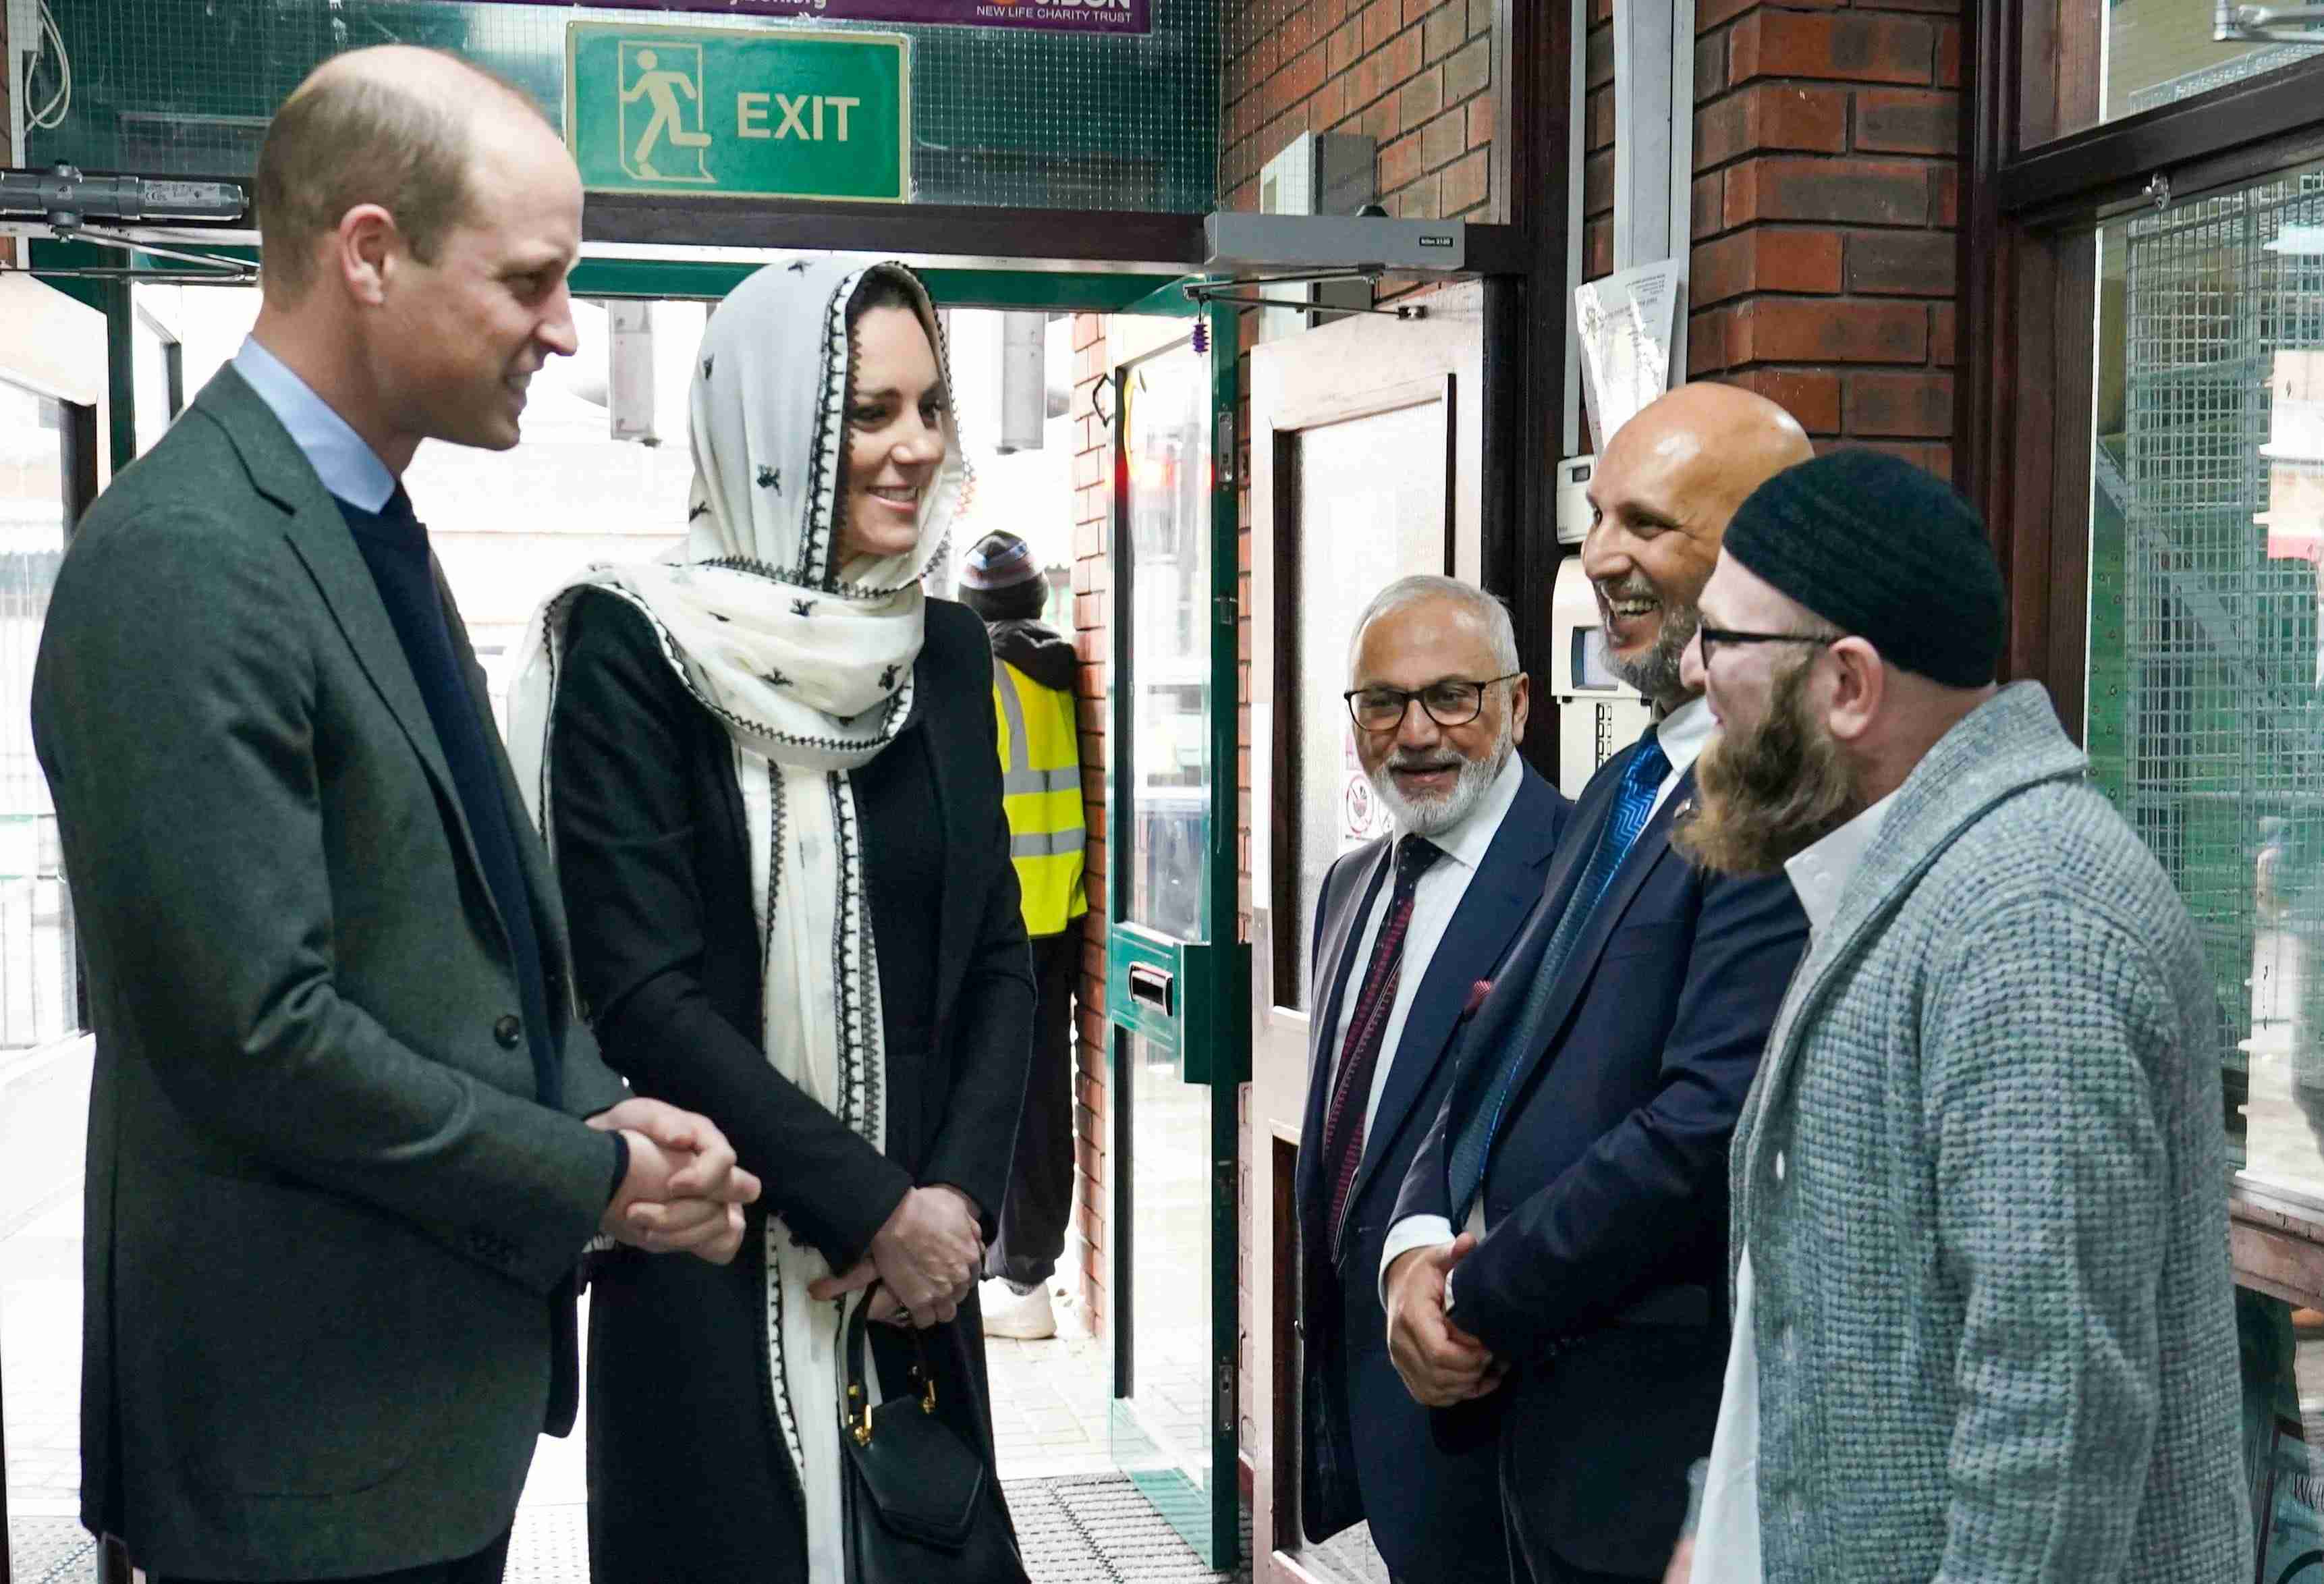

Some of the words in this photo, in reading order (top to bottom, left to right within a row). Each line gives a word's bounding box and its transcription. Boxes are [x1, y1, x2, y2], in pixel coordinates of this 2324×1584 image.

[976, 5, 1006, 16] NEW
[1009, 7, 1032, 18] LIFE
[1037, 7, 1090, 20] CHARITY
[1095, 10, 1132, 22] TRUST
[737, 92, 860, 142] EXIT
